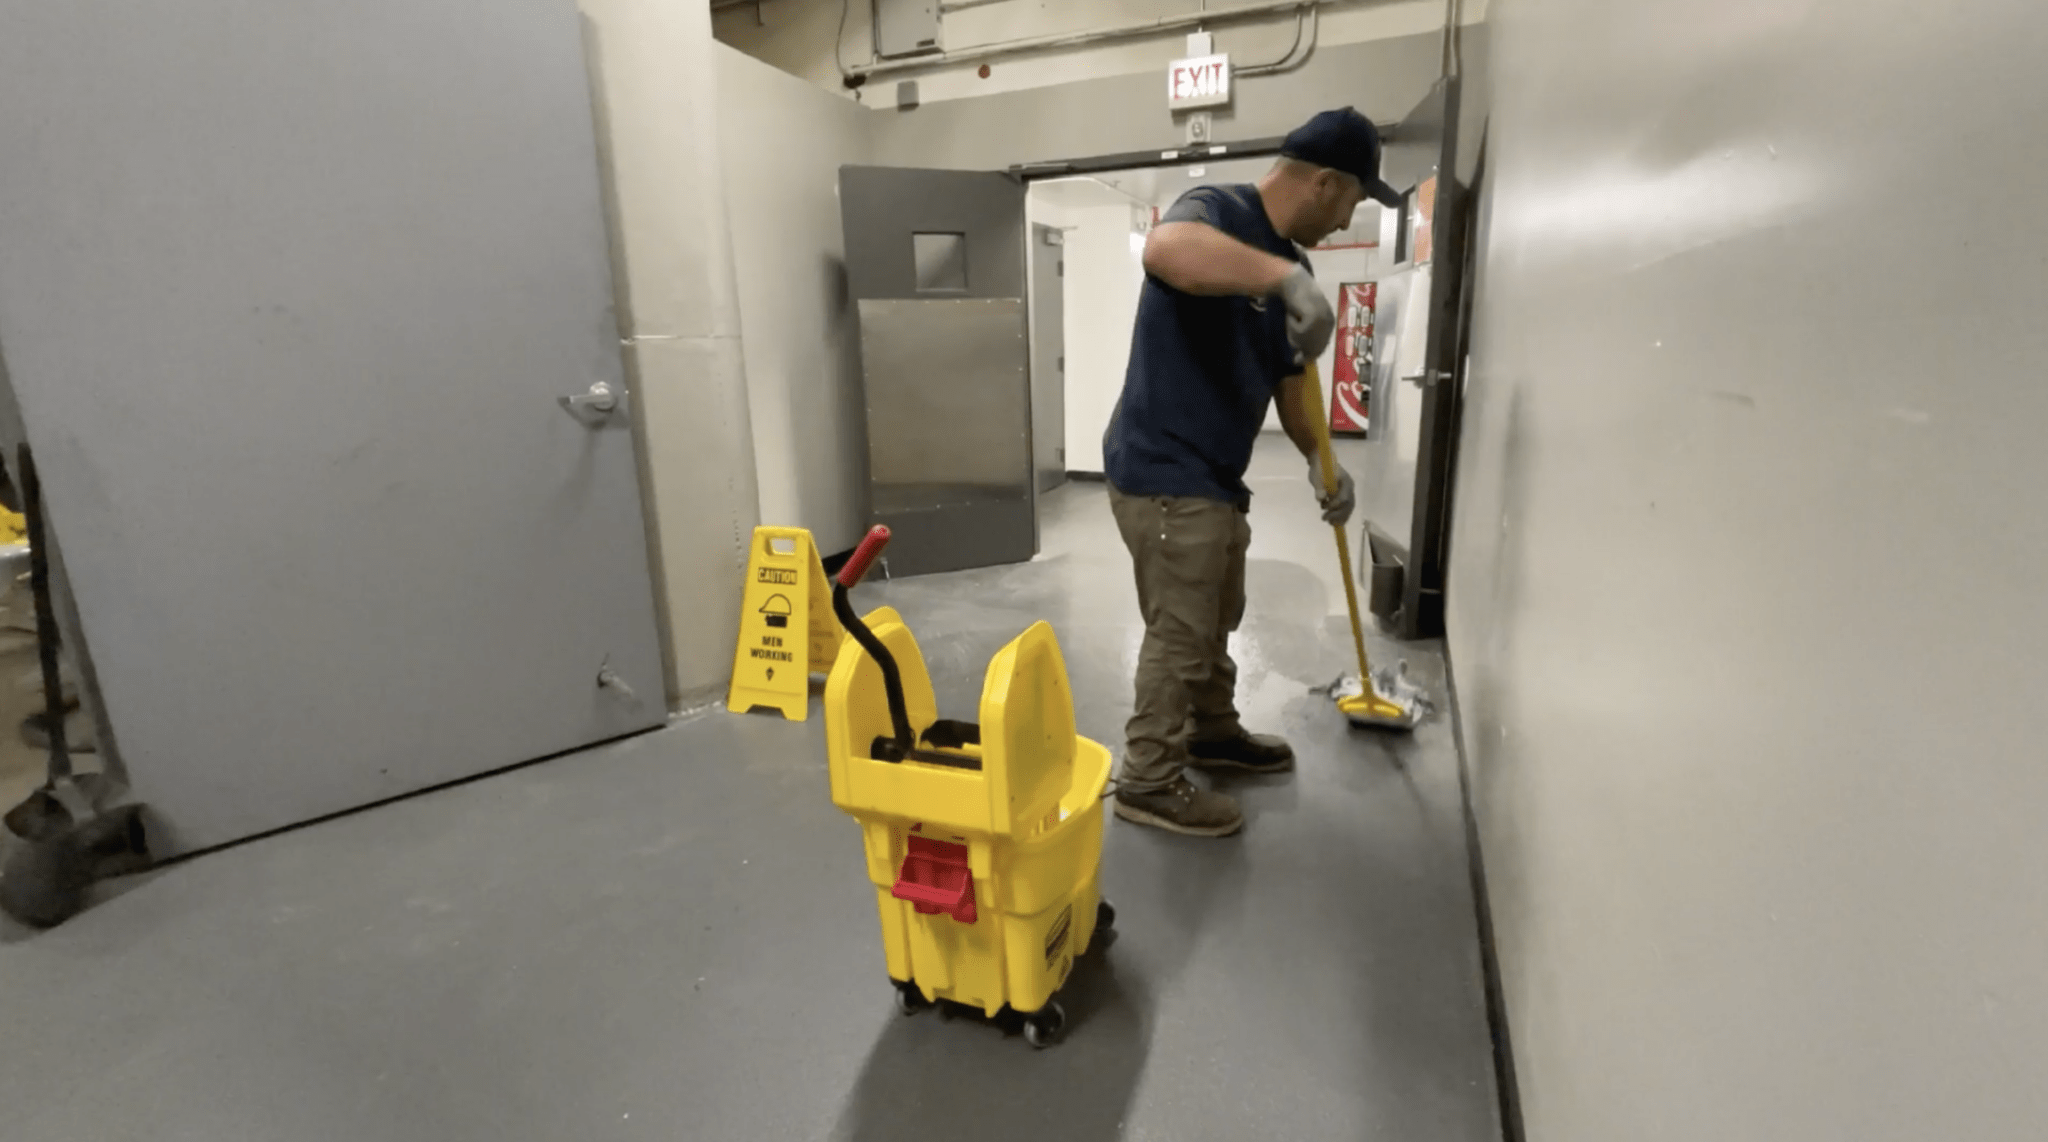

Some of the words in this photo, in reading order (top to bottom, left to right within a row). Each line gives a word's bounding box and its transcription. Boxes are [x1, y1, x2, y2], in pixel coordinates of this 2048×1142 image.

[1173, 63, 1223, 101] EXIT
[758, 567, 797, 585] CAUTION
[762, 636, 783, 647] MEN
[750, 648, 793, 662] WORKING
